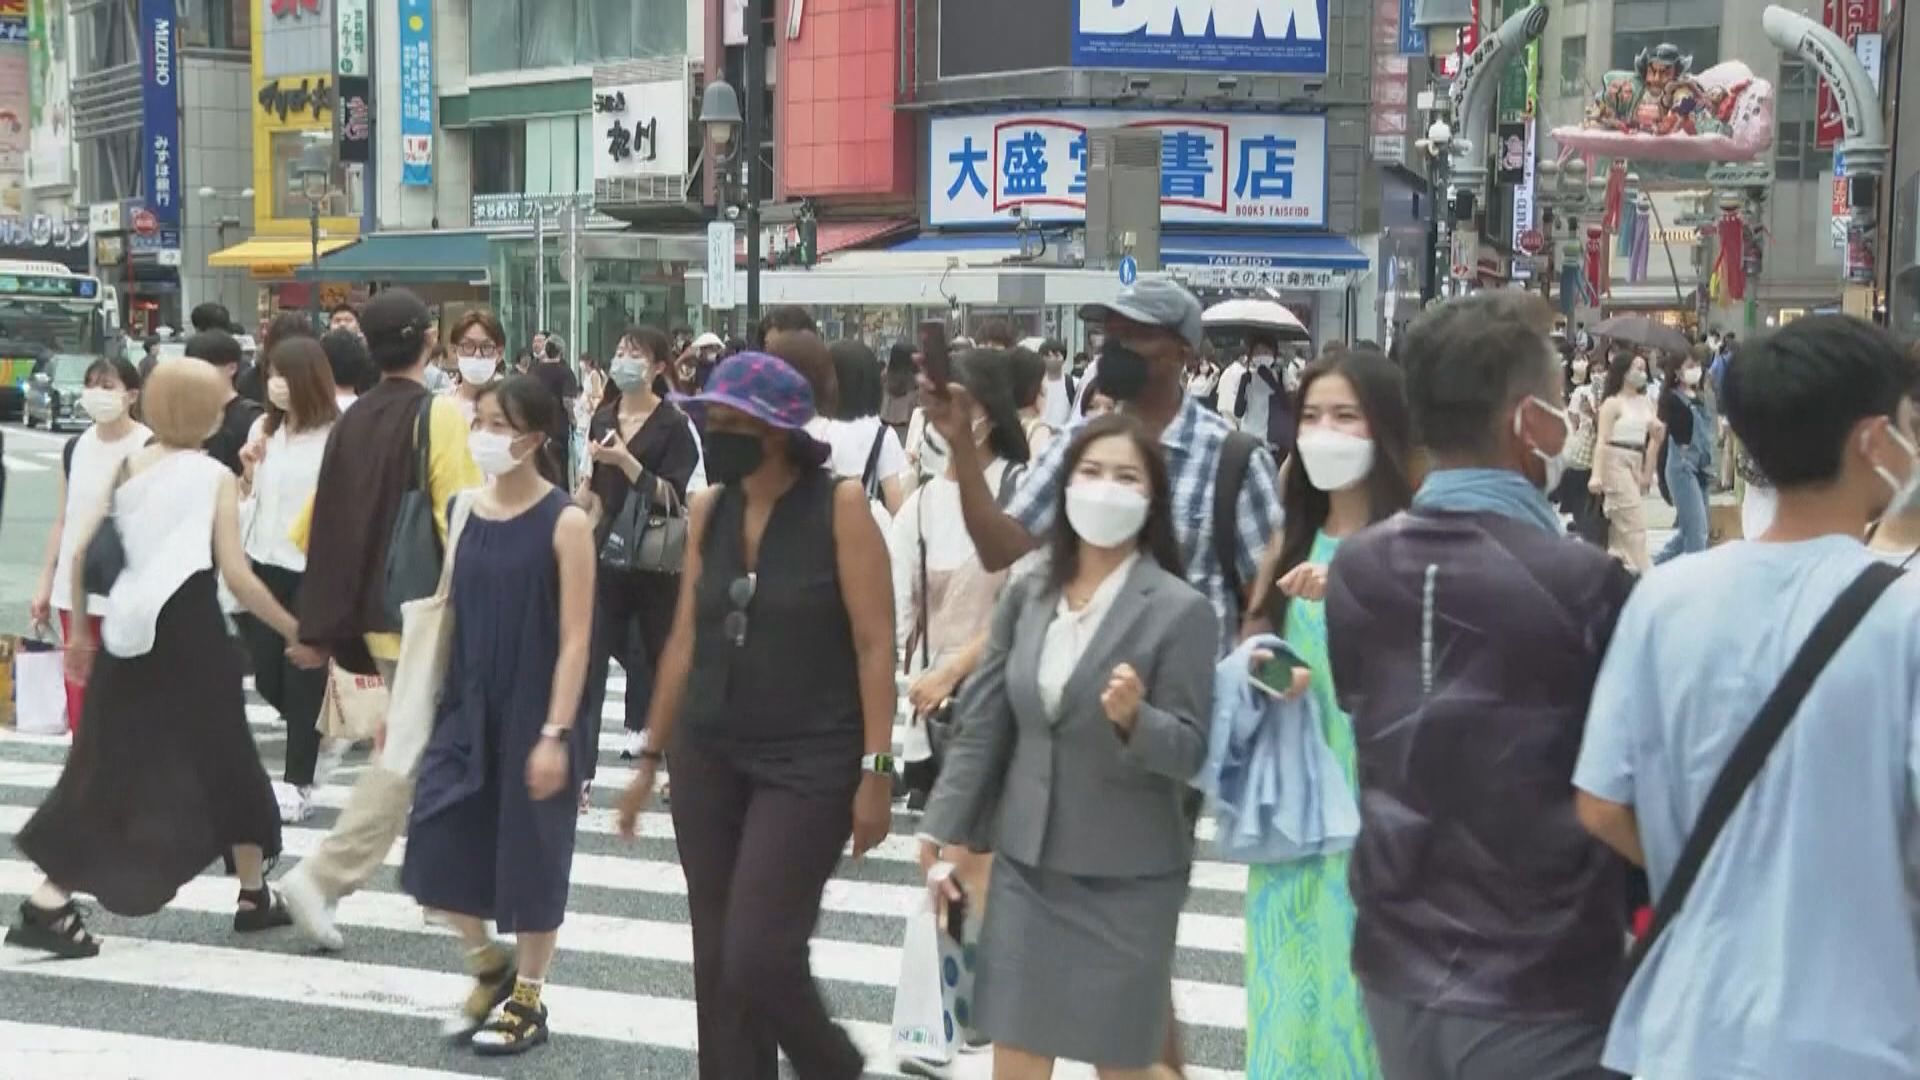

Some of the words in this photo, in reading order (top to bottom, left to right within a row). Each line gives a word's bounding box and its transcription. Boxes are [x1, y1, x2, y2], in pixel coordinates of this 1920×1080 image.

[154, 18, 170, 86] MIZUHO
[1236, 205, 1265, 217] BOOKS
[1269, 206, 1309, 217] TAISEIDO
[1208, 256, 1272, 267] TAISEIDO
